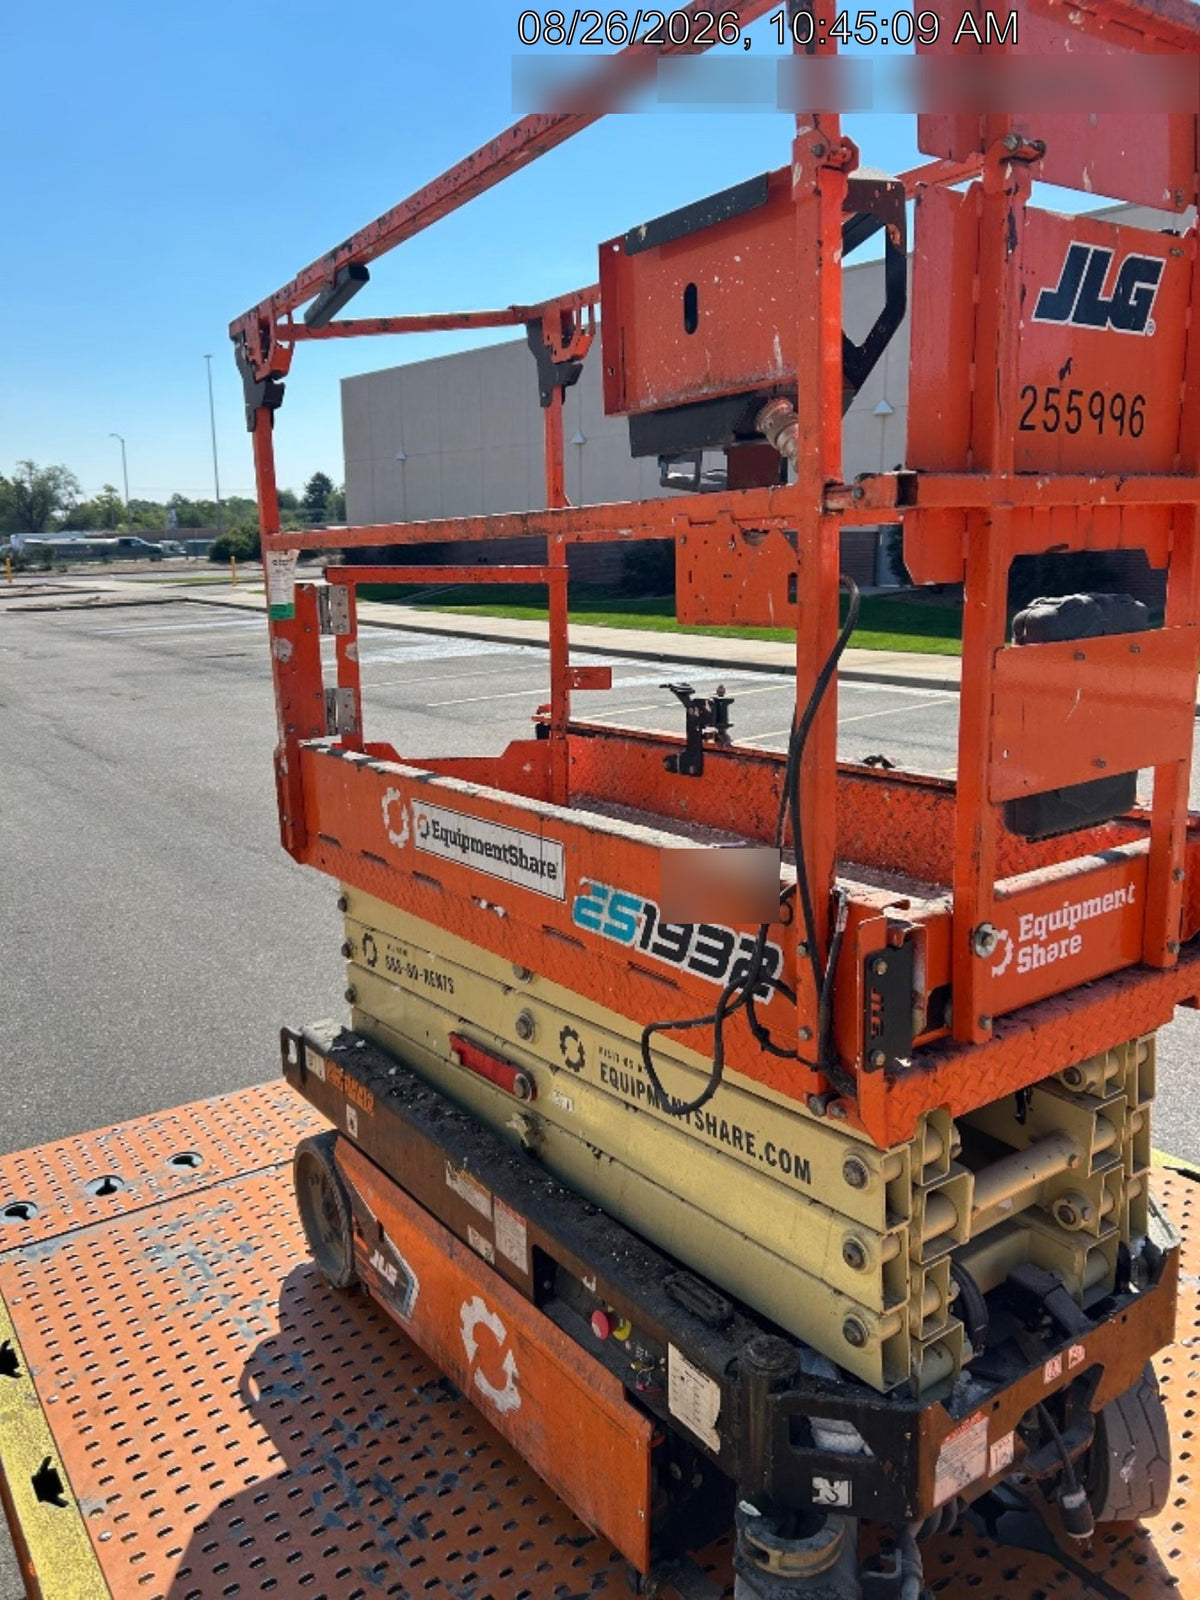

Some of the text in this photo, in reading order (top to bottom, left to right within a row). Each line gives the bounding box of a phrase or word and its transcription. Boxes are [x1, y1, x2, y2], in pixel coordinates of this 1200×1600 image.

[1018, 385, 1146, 438] 255996
[432, 818, 558, 880] EquipmentShare
[572, 876, 785, 1005] ES1932
[1018, 882, 1136, 942] Equipment
[1016, 934, 1082, 974] Share
[599, 1062, 812, 1185] EQUIPMNTSHARE.COM
